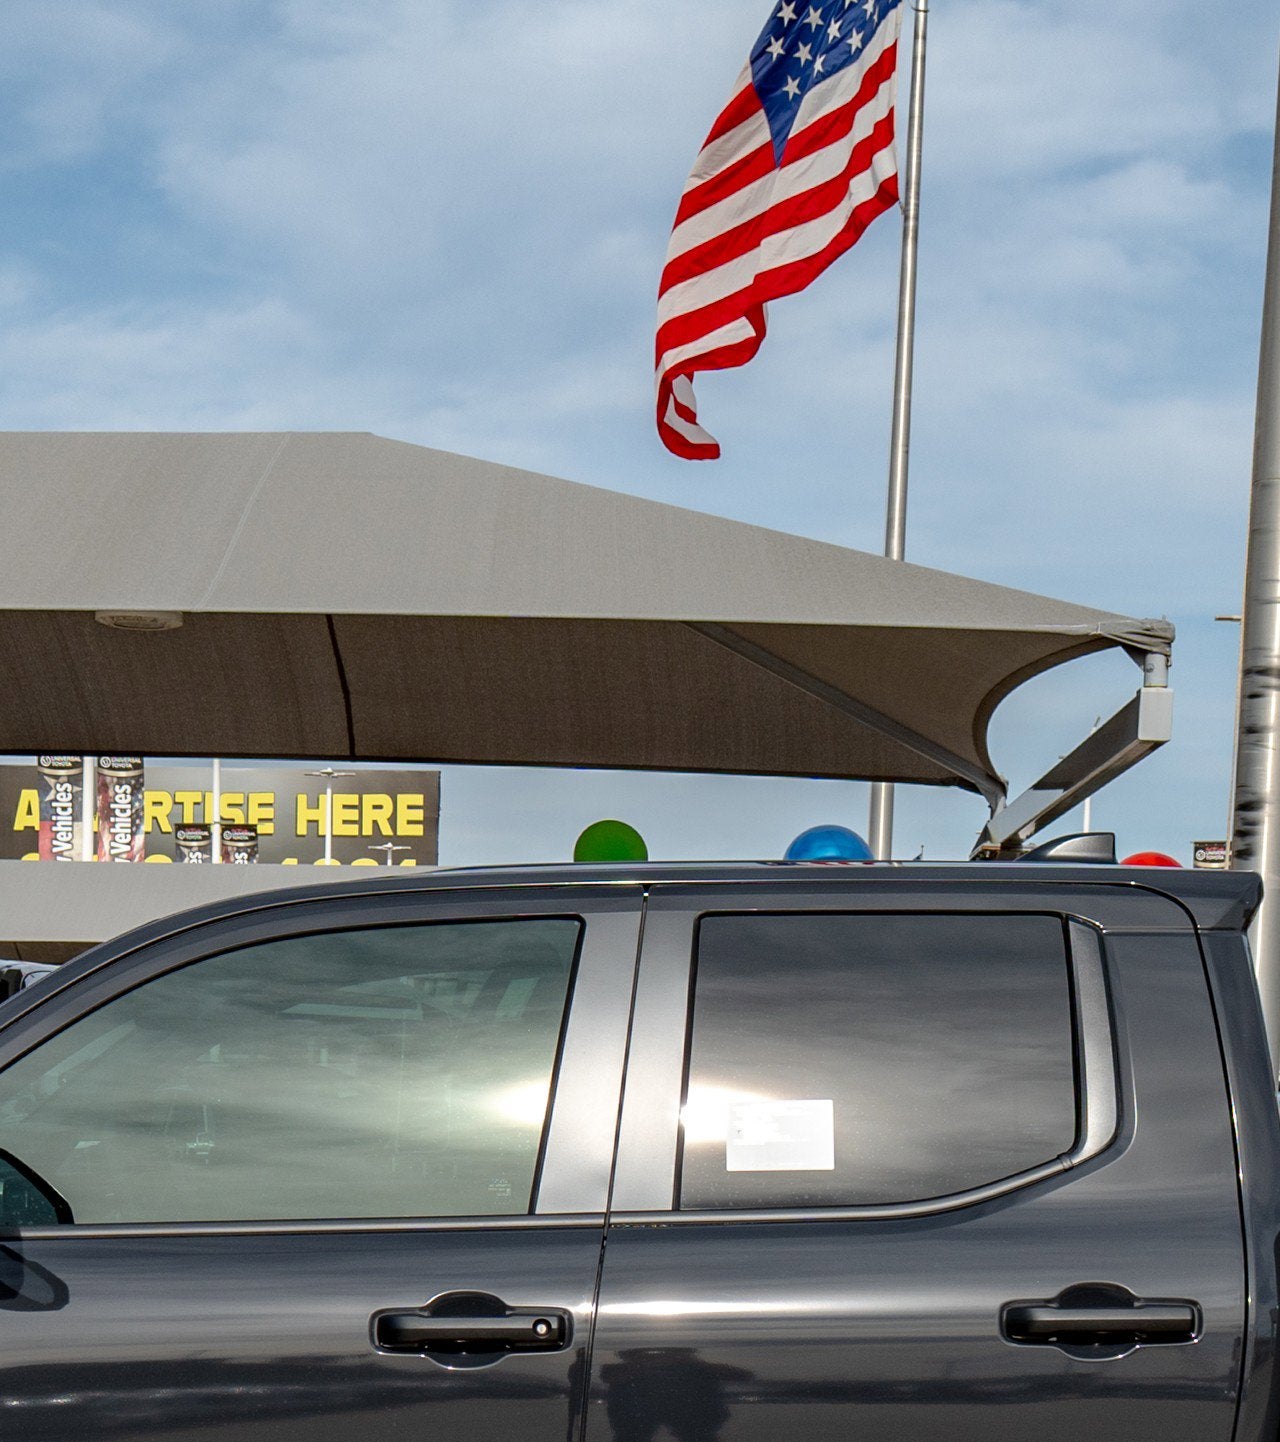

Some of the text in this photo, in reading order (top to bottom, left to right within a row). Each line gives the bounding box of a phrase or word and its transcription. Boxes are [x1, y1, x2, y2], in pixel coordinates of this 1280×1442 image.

[13, 789, 424, 836] ARTISE HERE
[51, 782, 74, 855] Vehicles
[109, 784, 132, 856] Vehicles
